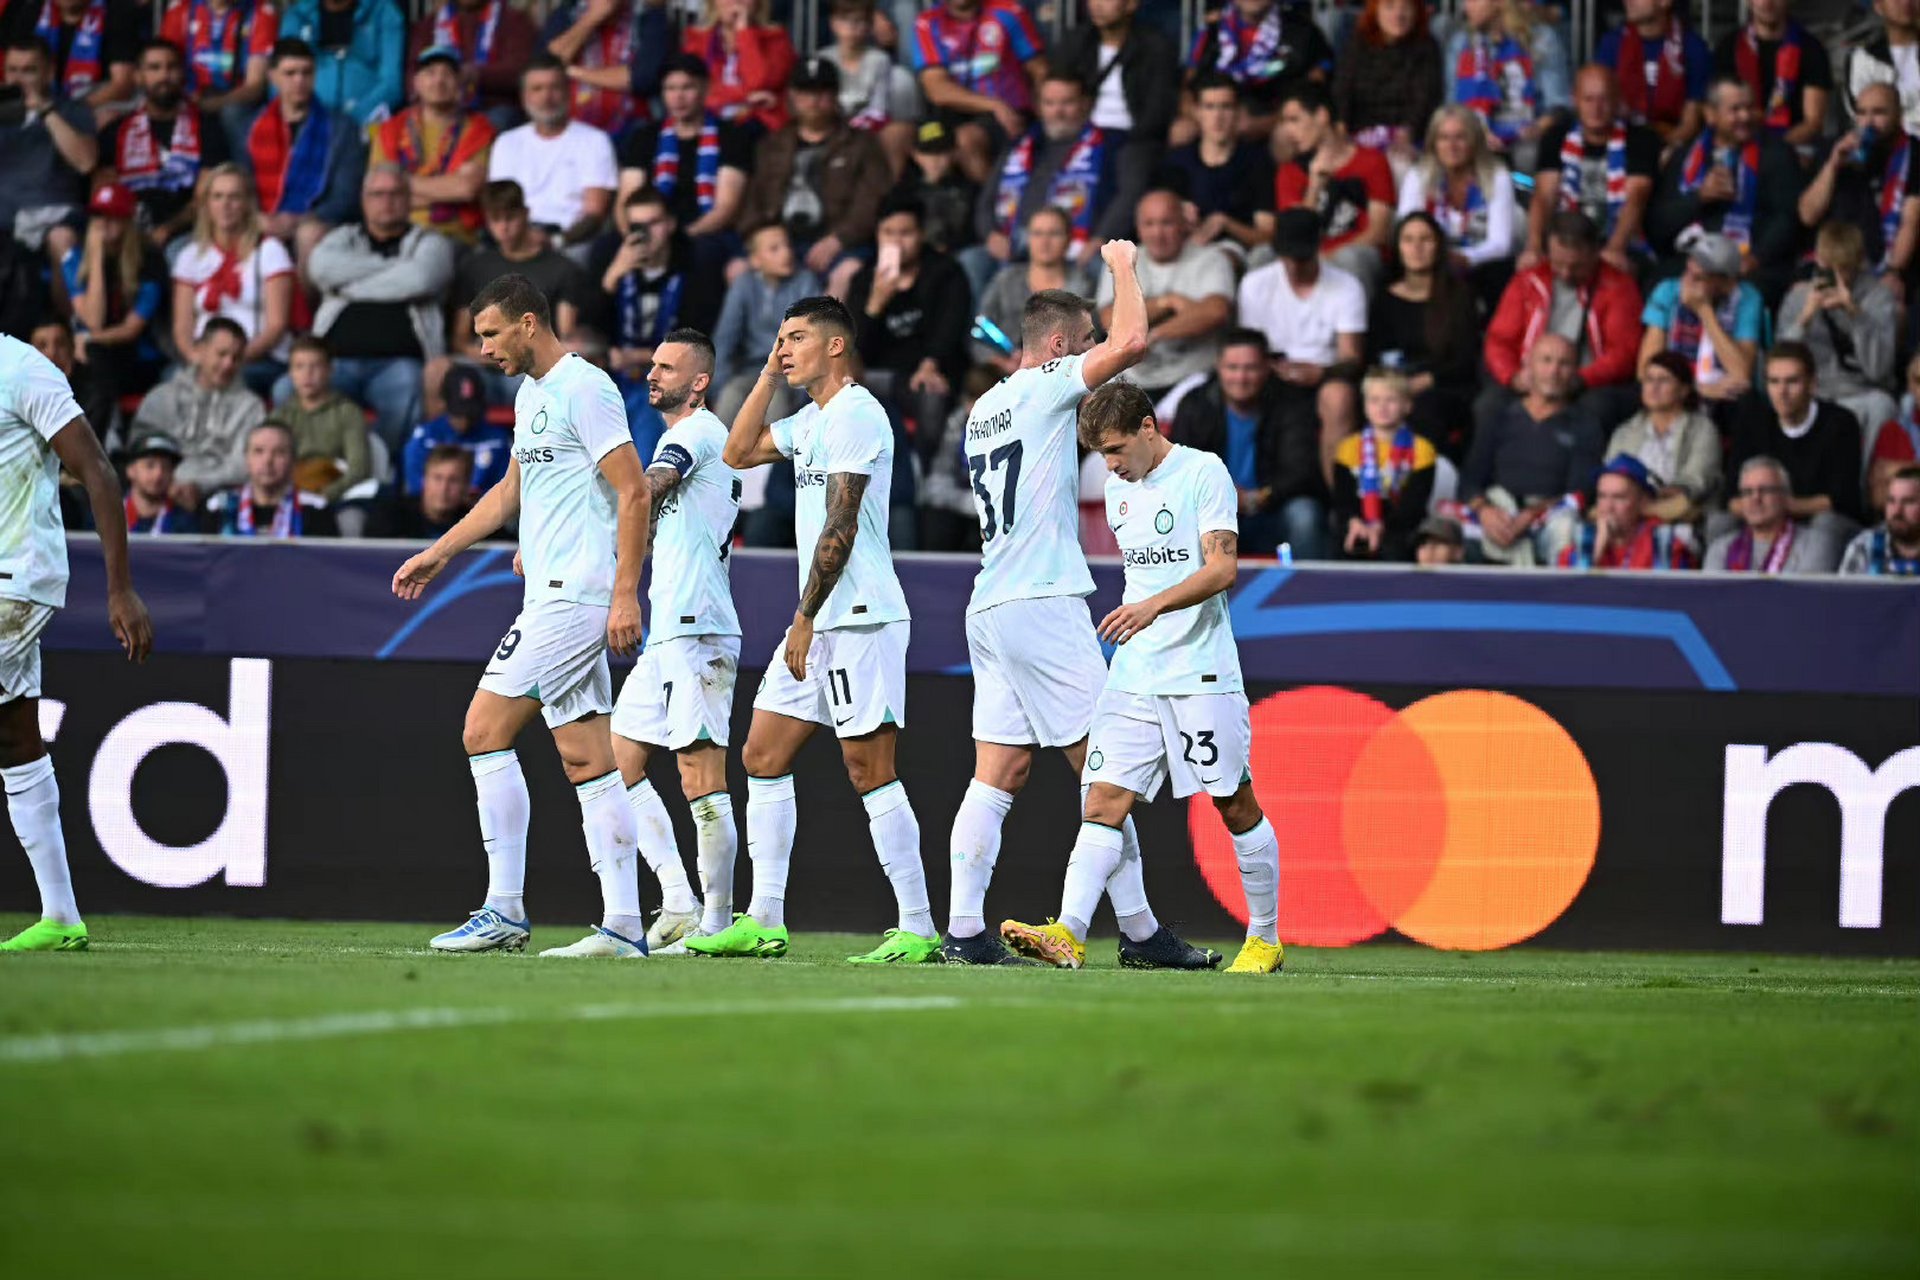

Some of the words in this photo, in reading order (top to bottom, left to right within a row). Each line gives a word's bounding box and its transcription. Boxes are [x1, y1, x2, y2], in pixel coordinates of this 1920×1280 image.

[969, 439, 1024, 542] 37
[496, 629, 522, 661] 9
[827, 668, 853, 706] 11
[1179, 730, 1219, 767] 23
